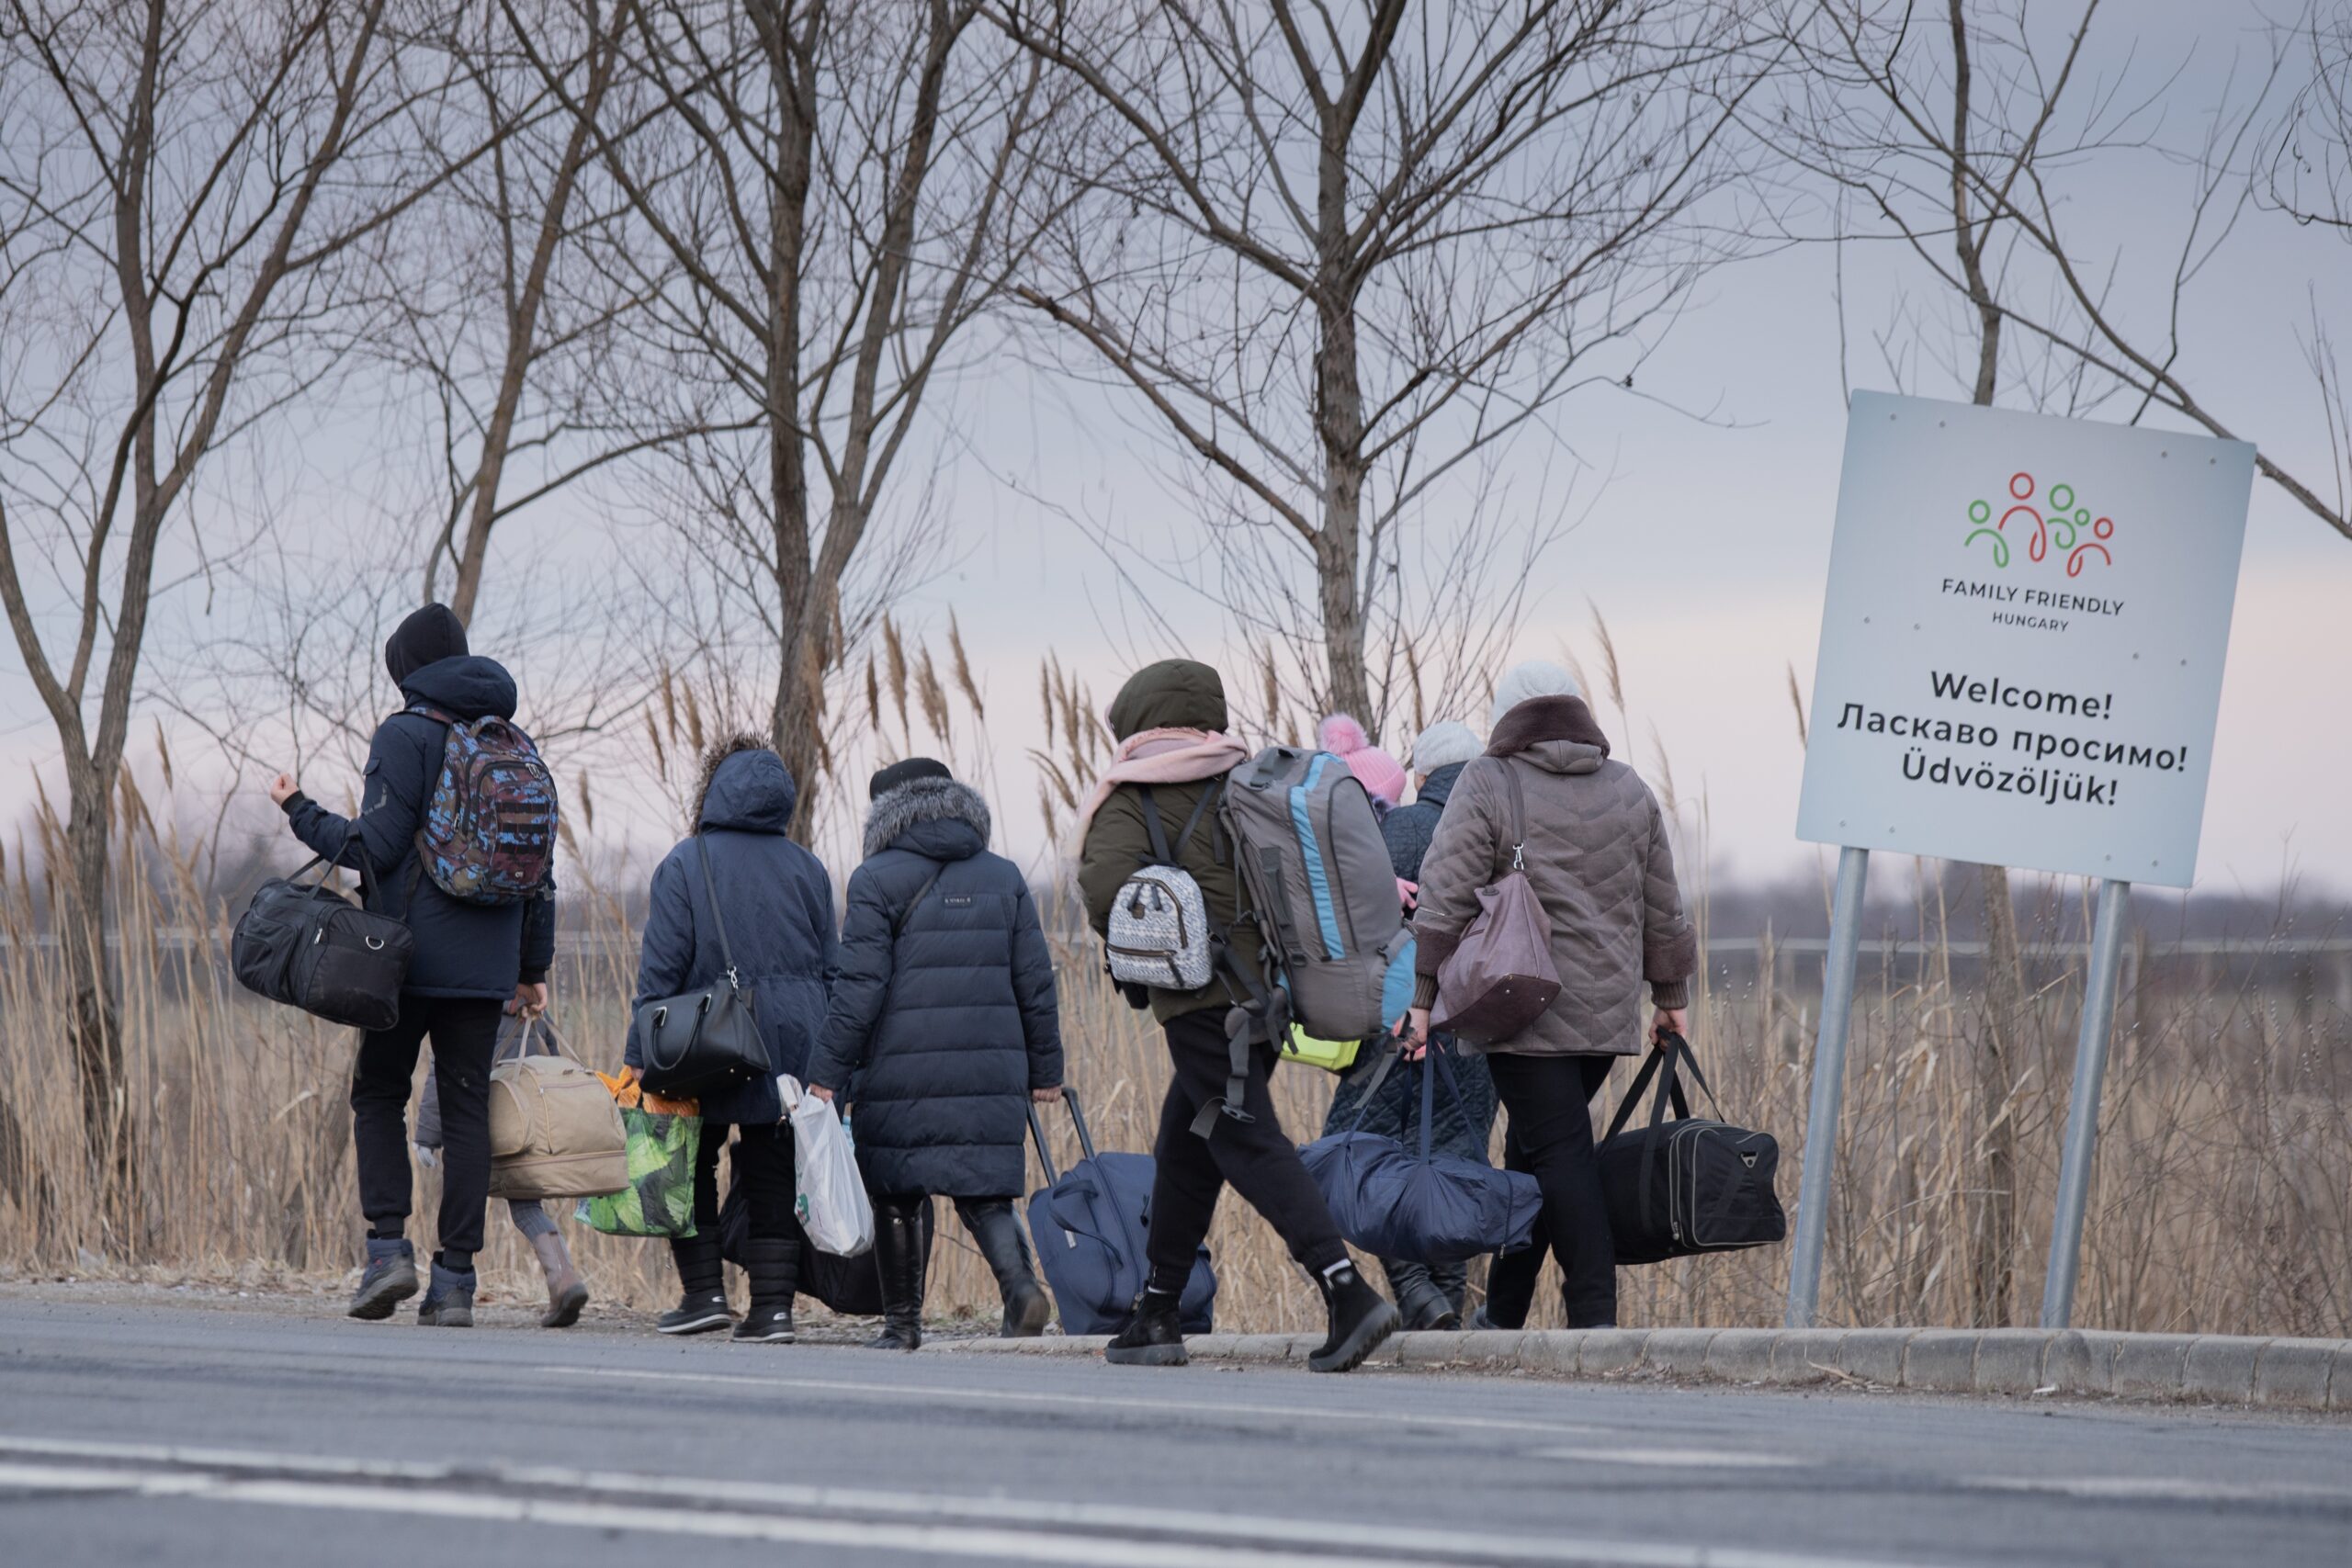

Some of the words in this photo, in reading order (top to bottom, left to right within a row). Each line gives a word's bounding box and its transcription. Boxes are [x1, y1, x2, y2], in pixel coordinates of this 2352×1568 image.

[1941, 578, 2019, 602] FAMILY
[2024, 589, 2125, 619] FRIENDLY
[1992, 611, 2070, 632] HUNGARY
[1930, 670, 2113, 721] Welcome!
[1837, 702, 1998, 748] Ласкаво
[2012, 730, 2188, 773] просимо!
[1902, 746, 2119, 807] Üdvözöljük!
